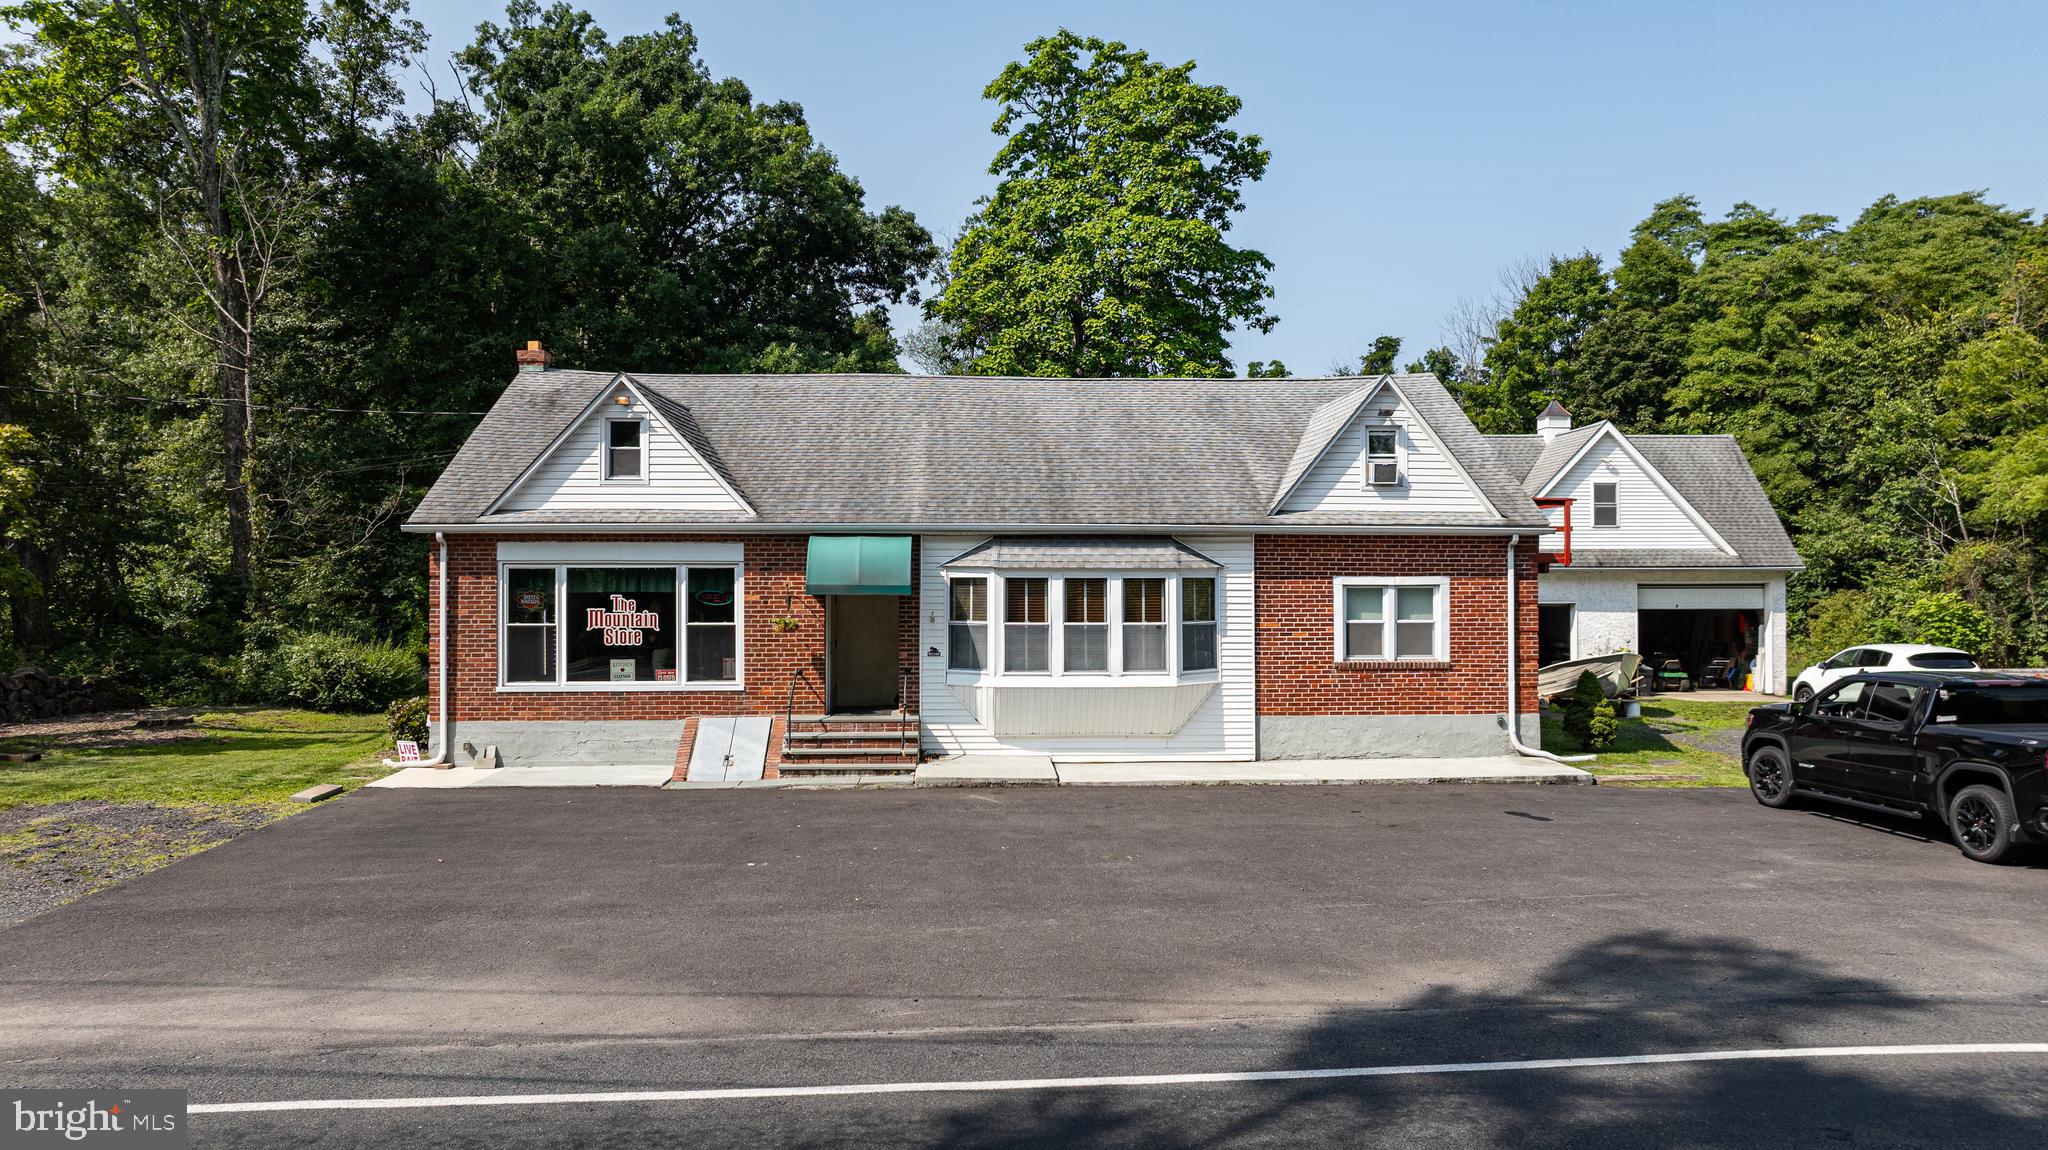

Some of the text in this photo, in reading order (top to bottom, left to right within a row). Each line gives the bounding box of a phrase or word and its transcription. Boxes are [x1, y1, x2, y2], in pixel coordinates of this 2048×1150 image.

[610, 594, 637, 613] The
[587, 608, 660, 631] Mountain
[603, 626, 643, 646] Store
[399, 744, 417, 755] LIVE
